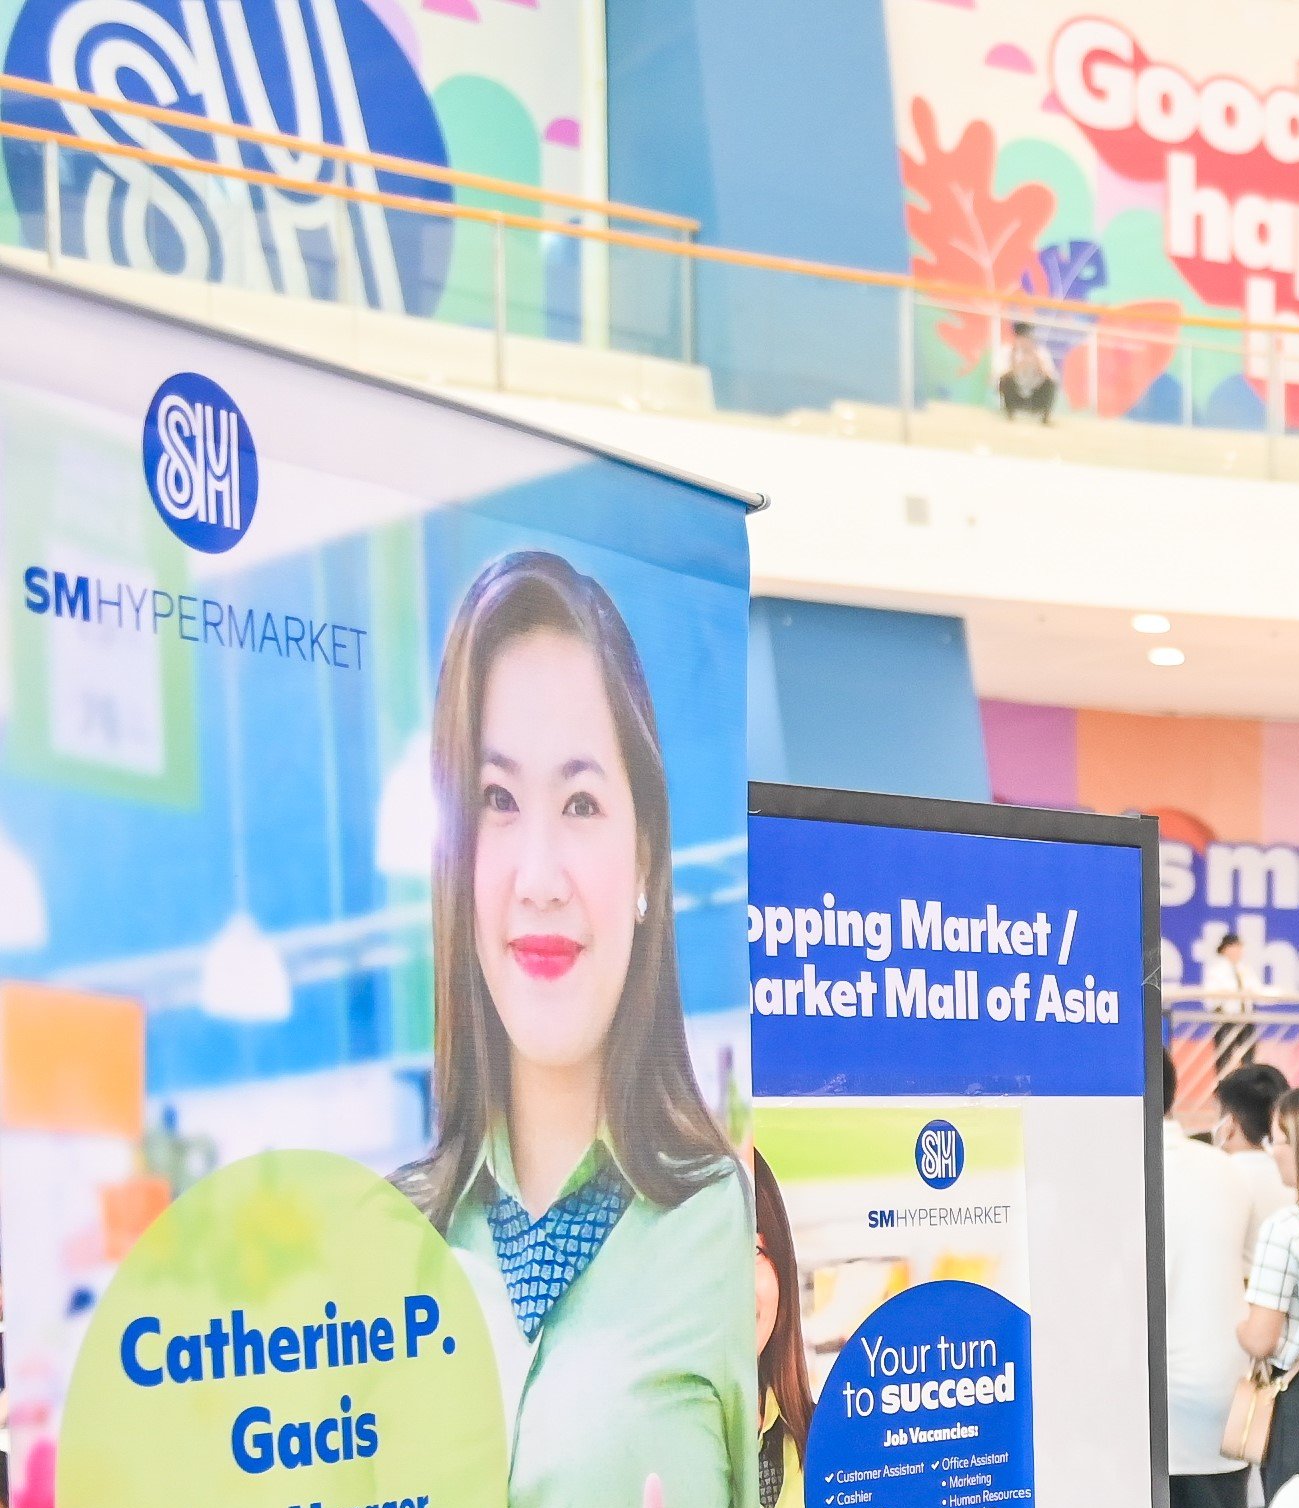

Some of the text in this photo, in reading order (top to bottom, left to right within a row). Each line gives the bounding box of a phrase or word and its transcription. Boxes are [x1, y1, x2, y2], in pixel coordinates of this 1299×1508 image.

[155, 394, 241, 531] SM
[900, 898, 1052, 957] Market
[750, 963, 1119, 1024] arket Mall of Asia
[920, 1130, 957, 1180] SM
[120, 1294, 456, 1387] Catherine P.
[861, 1335, 997, 1378] Your turn
[842, 1362, 1016, 1418] to succeed
[230, 1394, 379, 1474] Gacis
[883, 1422, 979, 1448] Job Vacancies:
[837, 1462, 924, 1484] Customer Assistant
[942, 1452, 1008, 1471] Office Assistant
[949, 1473, 992, 1489] Marketing
[837, 1491, 873, 1505] Cashier
[949, 1488, 1032, 1507] Human Resources
